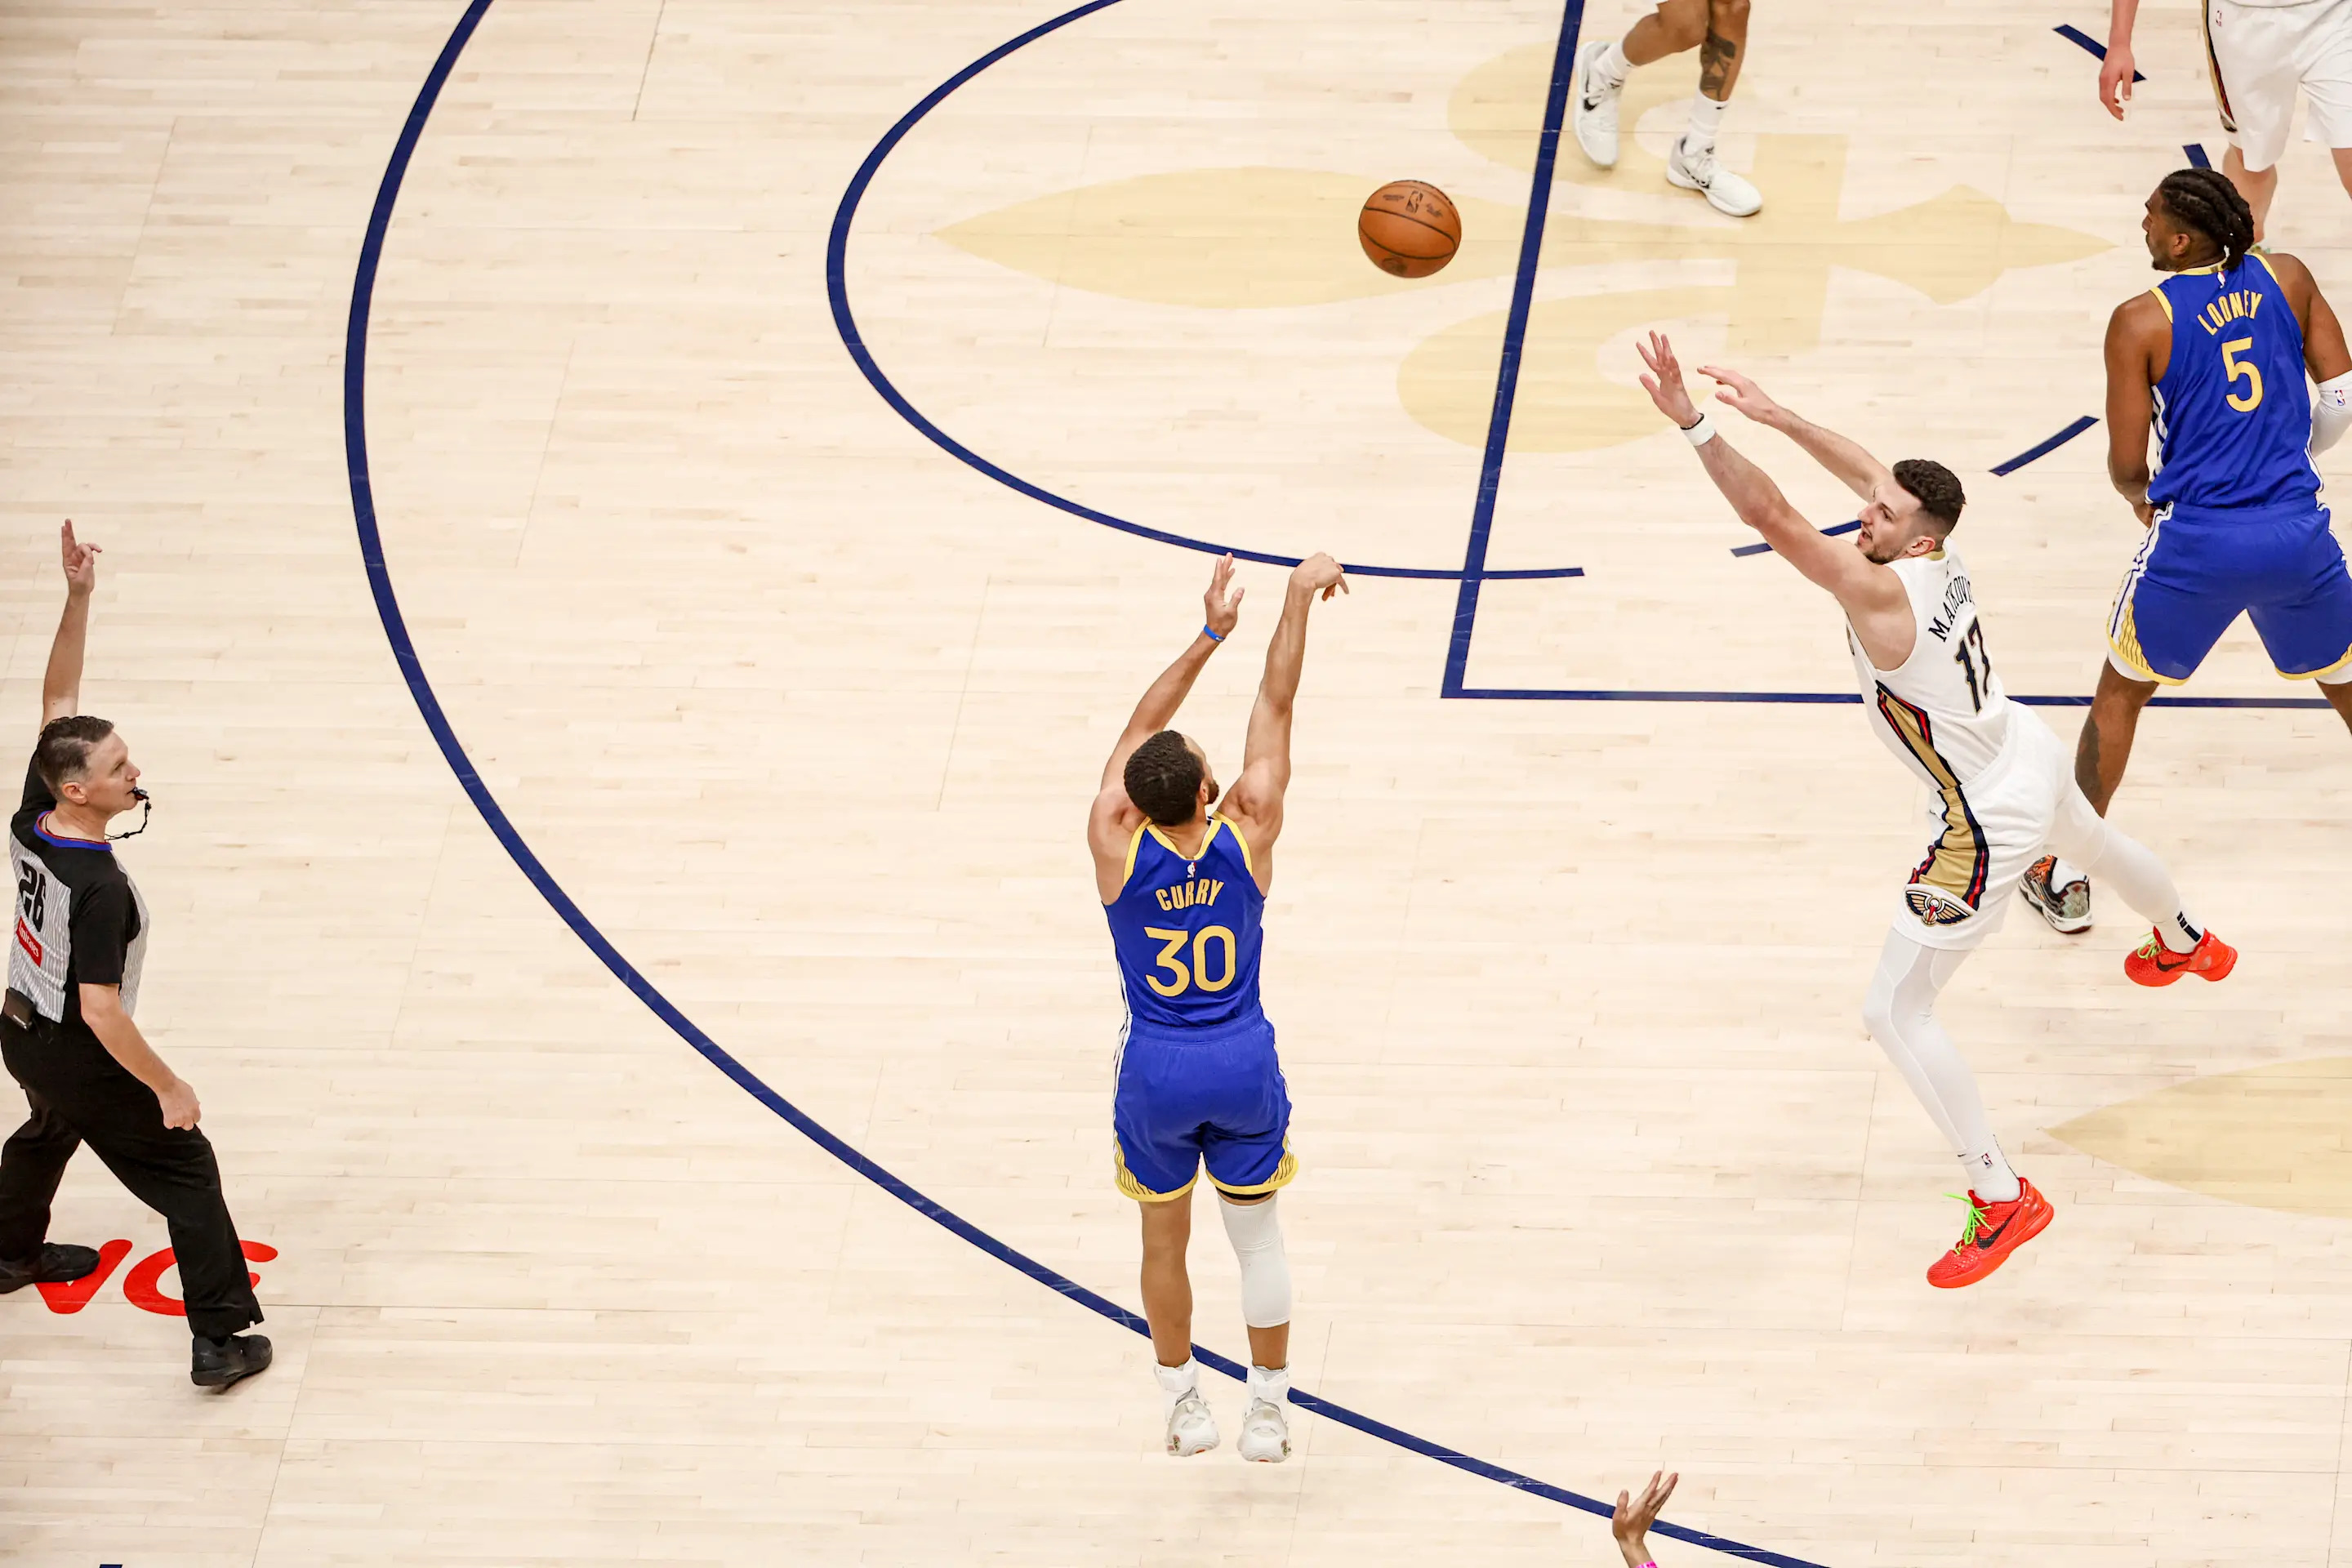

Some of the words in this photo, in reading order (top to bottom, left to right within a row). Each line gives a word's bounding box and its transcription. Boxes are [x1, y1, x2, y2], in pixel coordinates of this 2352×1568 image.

[2197, 289, 2263, 336] LOONEY
[2221, 336, 2264, 412] 5
[1928, 576, 1975, 643] MATKOVI
[1955, 615, 1990, 715] 17
[19, 860, 47, 932] 26
[1155, 879, 1225, 911] CURRY
[1143, 925, 1236, 997] 30
